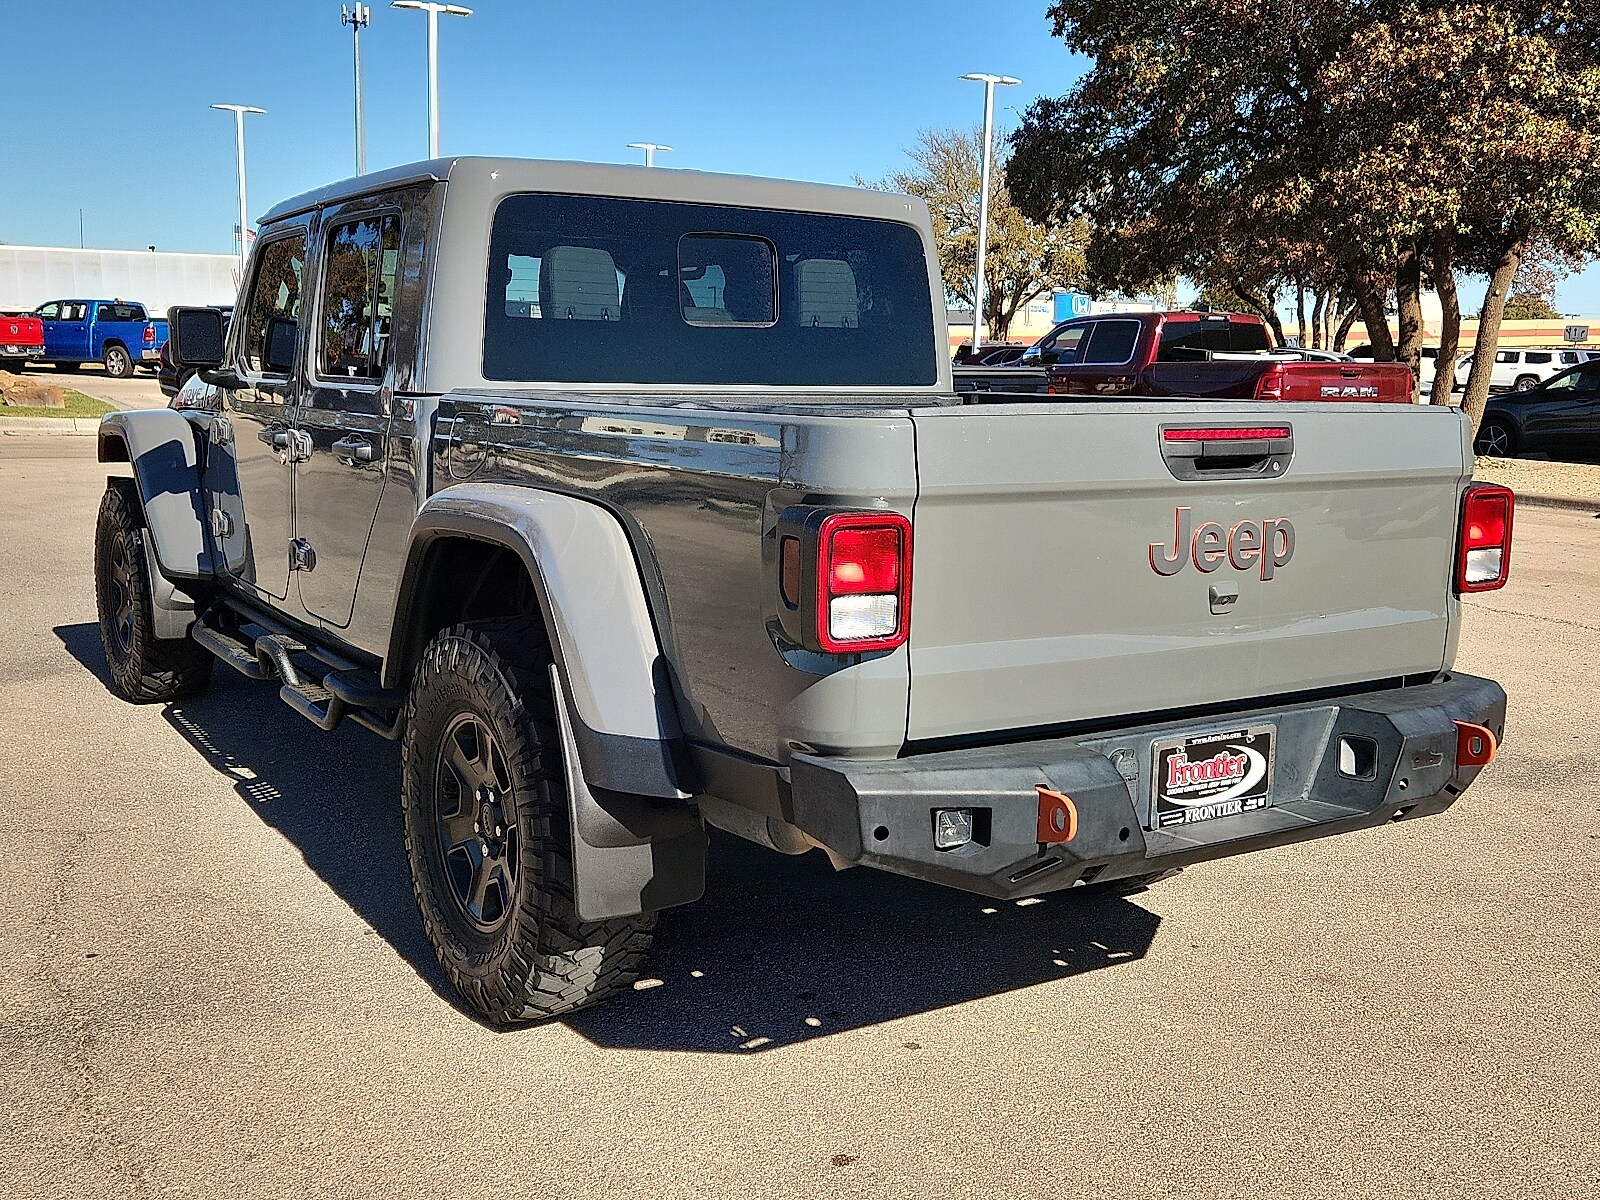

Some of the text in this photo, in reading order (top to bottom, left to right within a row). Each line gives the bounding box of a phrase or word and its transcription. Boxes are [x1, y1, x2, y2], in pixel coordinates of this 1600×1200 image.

[1320, 386, 1379, 398] RAM
[1149, 506, 1296, 581] Jeep
[1167, 752, 1246, 787] Frontier
[1184, 800, 1243, 823] FRONTIER
